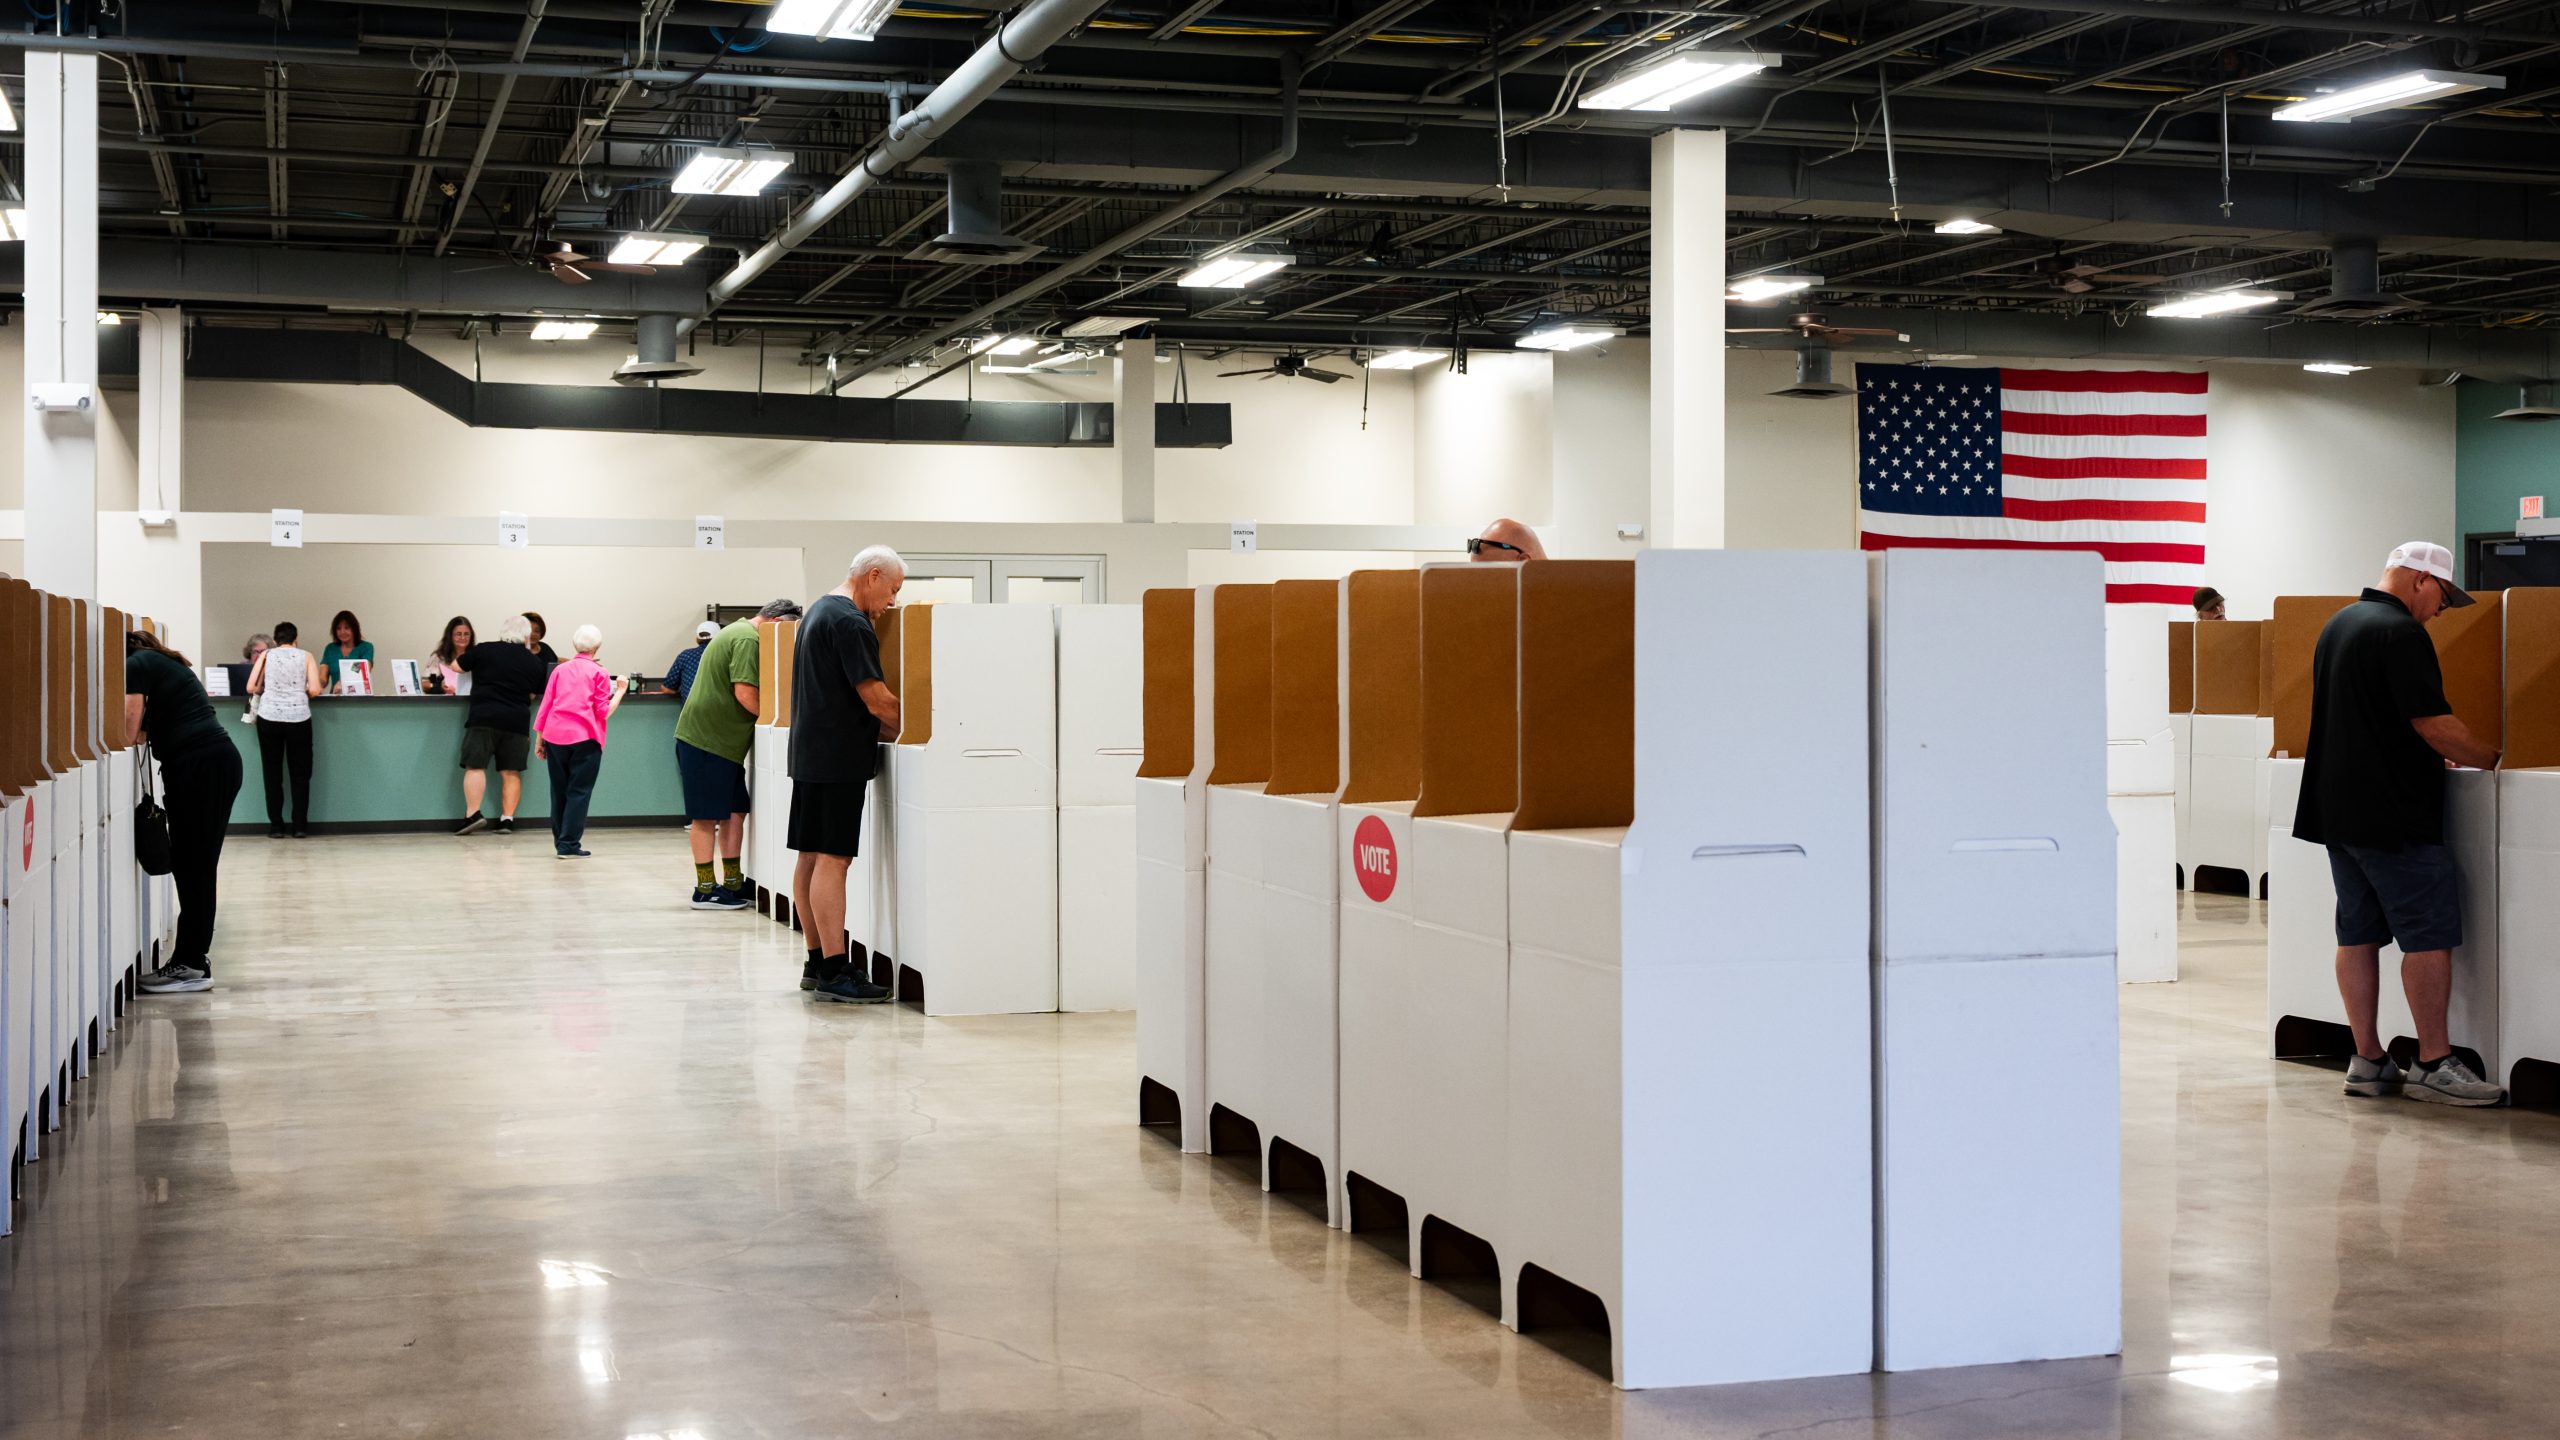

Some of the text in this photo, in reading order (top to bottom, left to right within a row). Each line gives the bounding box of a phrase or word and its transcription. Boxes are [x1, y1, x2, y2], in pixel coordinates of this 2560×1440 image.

[2524, 497, 2539, 516] EXIT
[284, 531, 290, 539] 4
[510, 534, 516, 542] 3
[1360, 844, 1391, 875] VOTE
